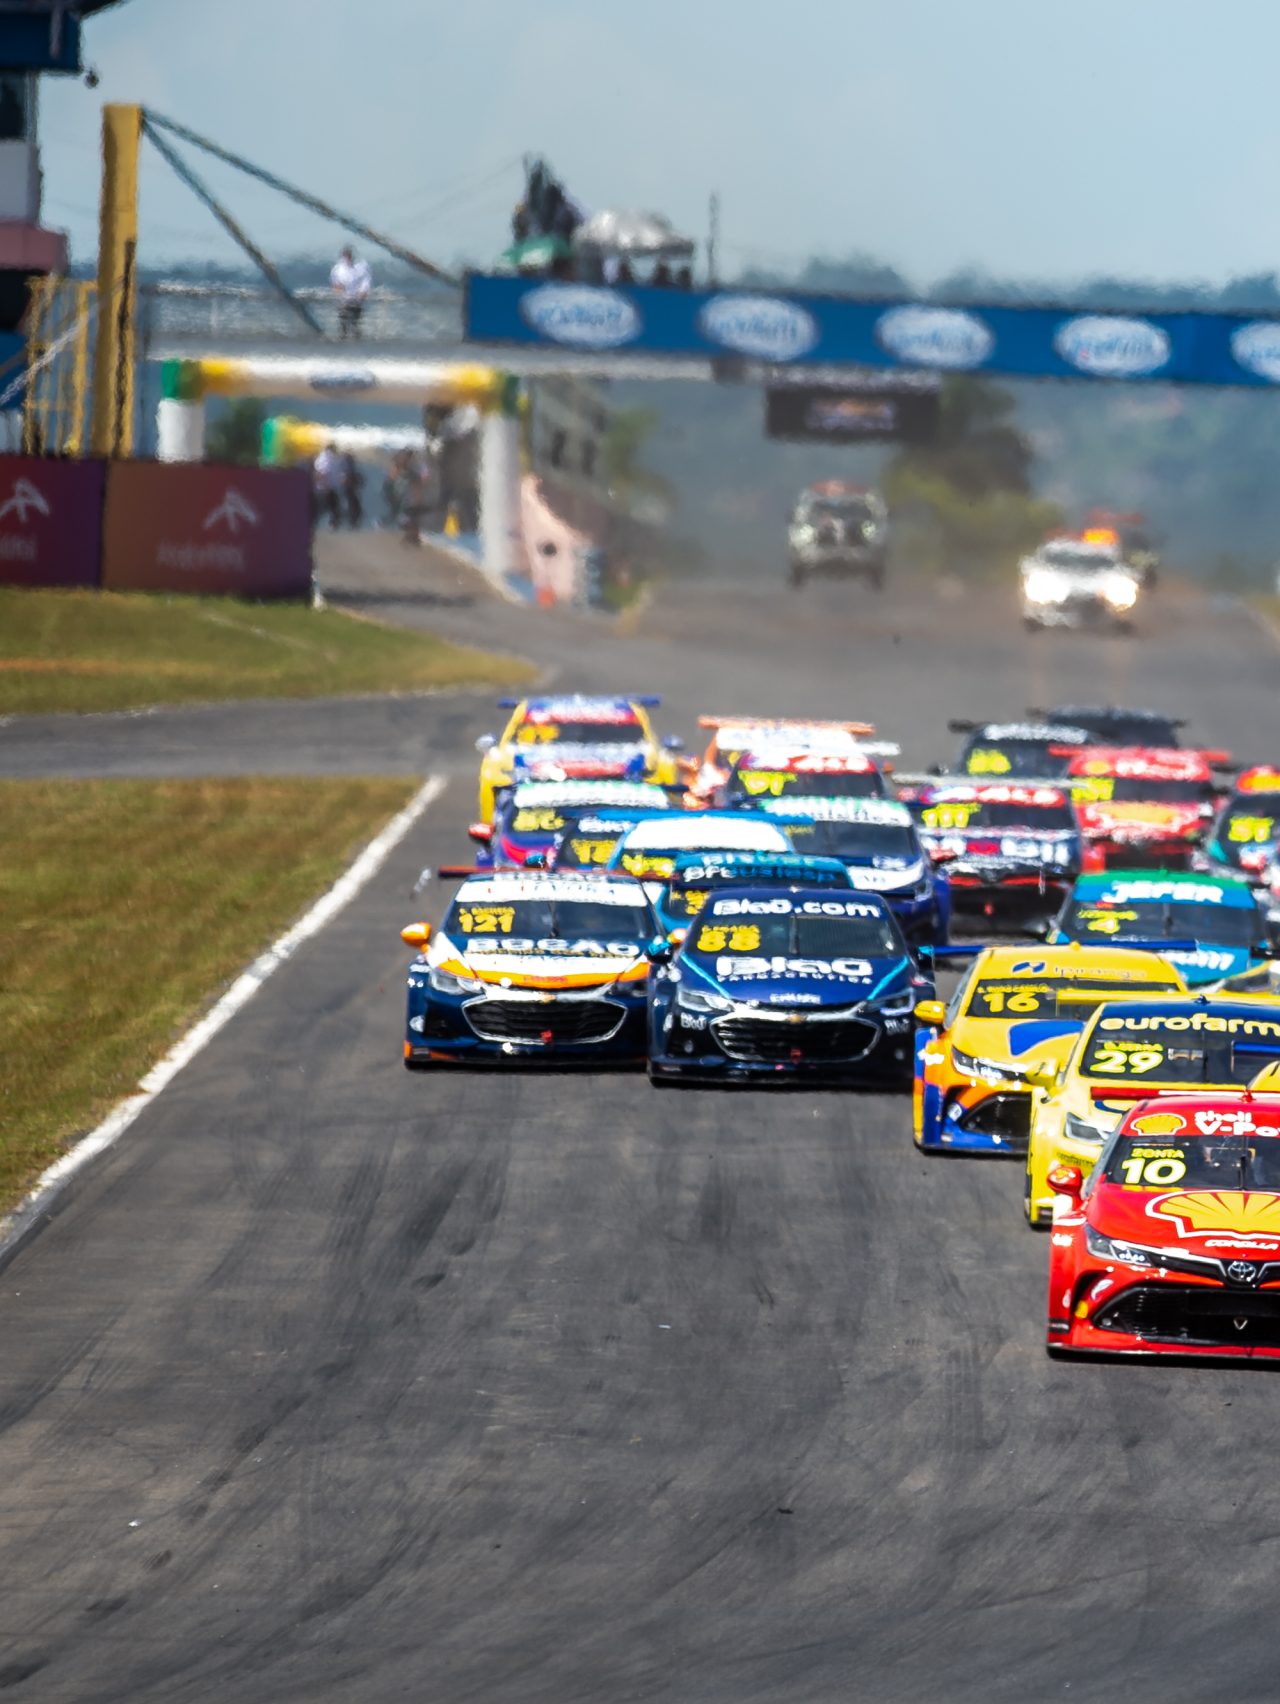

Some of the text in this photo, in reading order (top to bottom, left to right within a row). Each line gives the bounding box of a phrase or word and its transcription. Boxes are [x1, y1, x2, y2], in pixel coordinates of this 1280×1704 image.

[459, 913, 513, 933] 121
[697, 931, 760, 952] 88
[983, 993, 1040, 1012] 16
[1090, 1050, 1163, 1073] 29
[1122, 1158, 1187, 1184] 10
[1205, 1239, 1279, 1250] COROLLA
